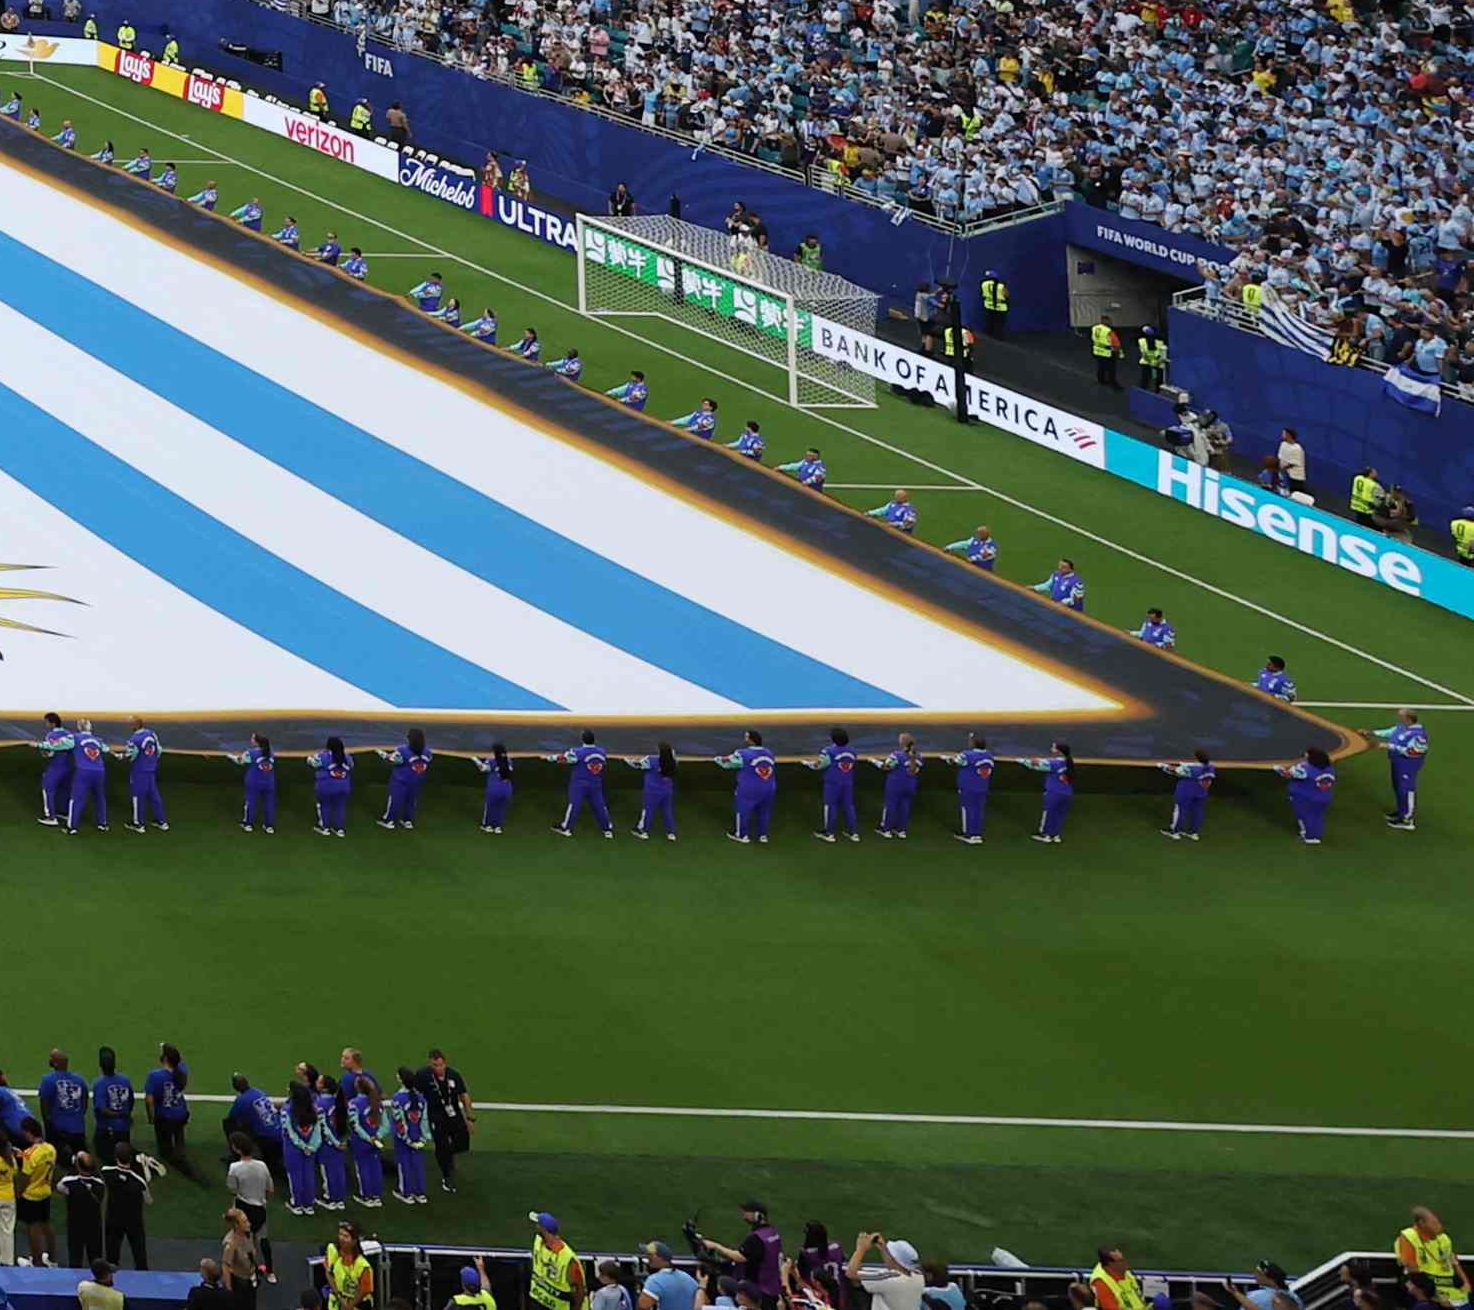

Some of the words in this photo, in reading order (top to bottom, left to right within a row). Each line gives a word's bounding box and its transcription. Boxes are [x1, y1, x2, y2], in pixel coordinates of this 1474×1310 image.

[118, 53, 153, 80] Lay's
[365, 53, 394, 78] FIFA
[187, 76, 223, 107] Lay's
[284, 116, 354, 163] verizon
[399, 158, 475, 209] Michelob
[498, 195, 579, 253] ULTRA
[1097, 225, 1122, 244] FIFA
[1124, 229, 1168, 259] WORLD
[1170, 246, 1196, 268] CUP
[821, 327, 887, 372] BANK
[895, 358, 927, 384] OF
[1158, 448, 1423, 597] Hisense
